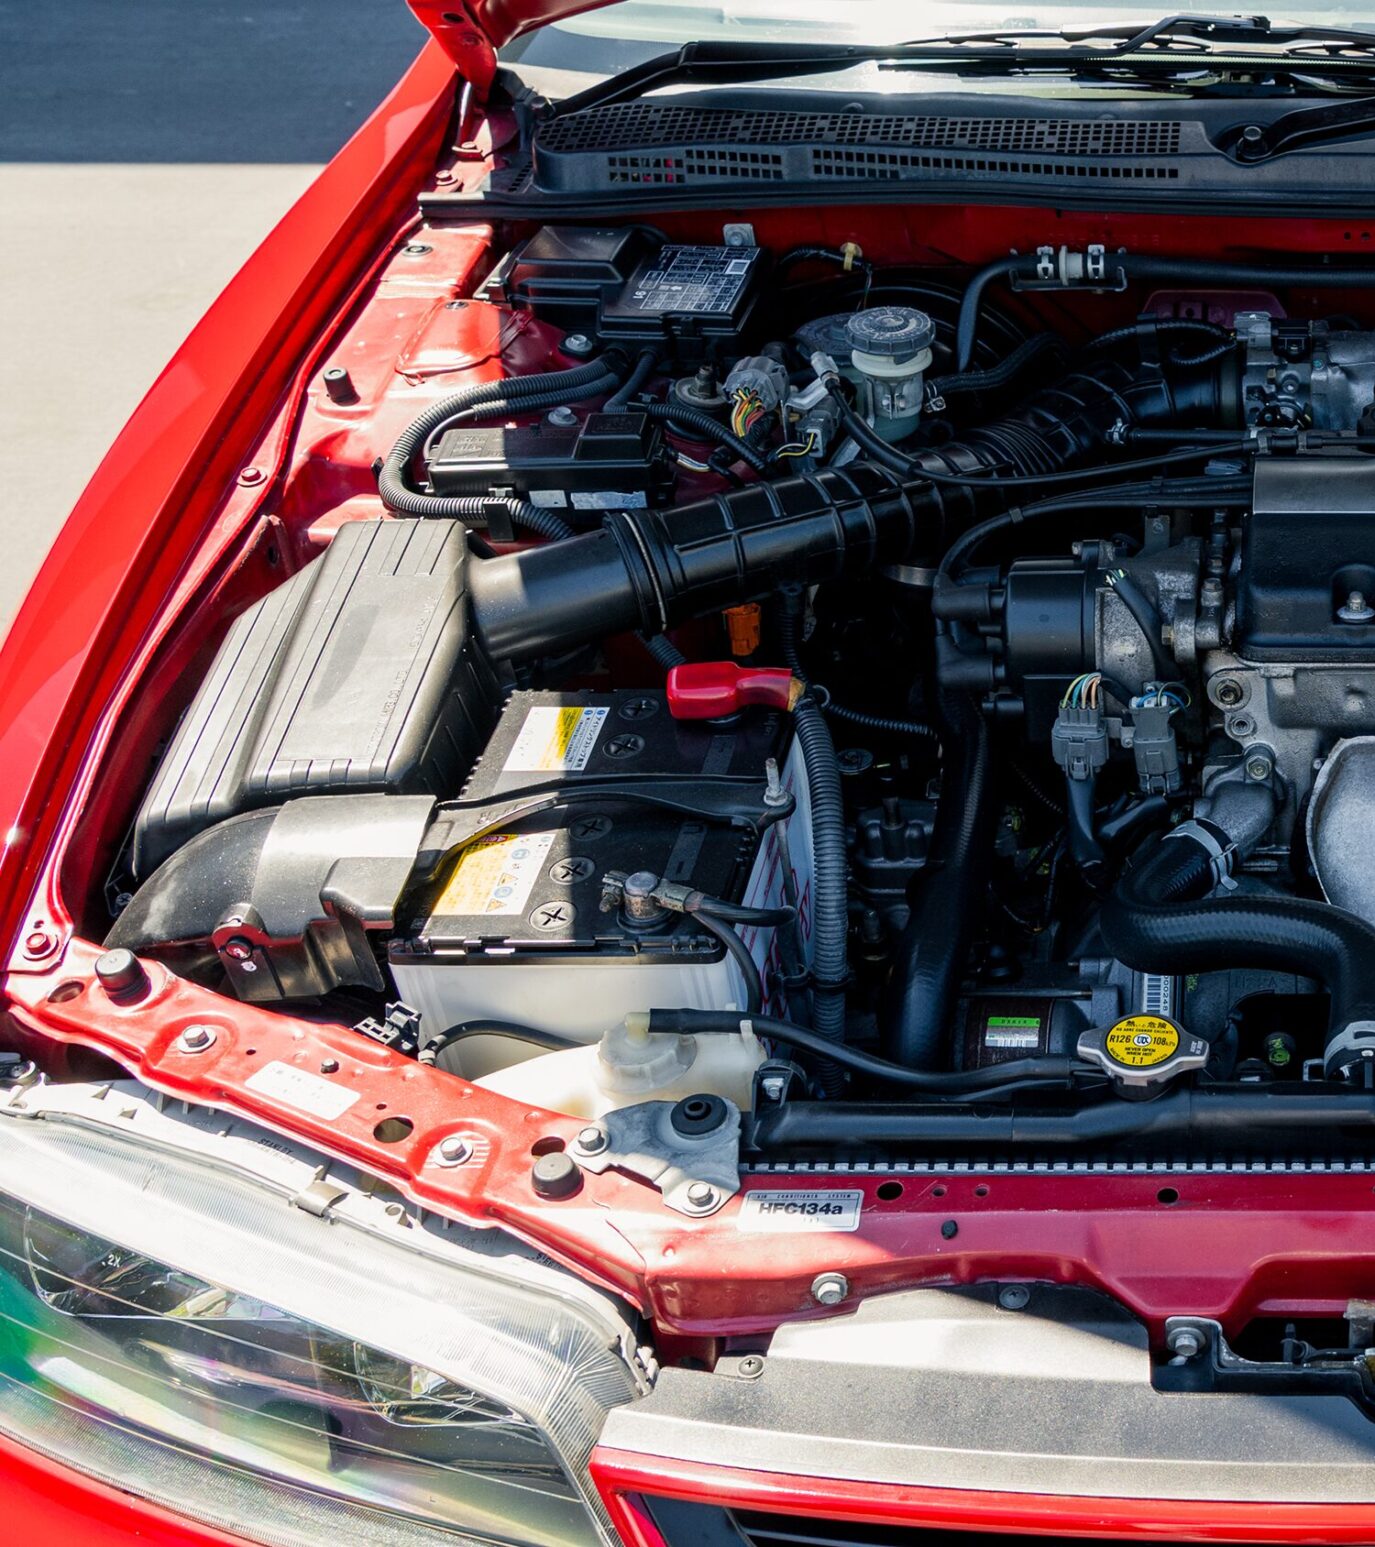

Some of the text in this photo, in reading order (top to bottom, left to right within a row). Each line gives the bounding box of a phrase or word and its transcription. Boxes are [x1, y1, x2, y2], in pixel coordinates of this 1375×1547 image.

[1109, 1035, 1131, 1043] R126
[1131, 1056, 1144, 1064] 1.1
[260, 1138, 294, 1155] STANLEY
[759, 1202, 844, 1215] HFC134a
